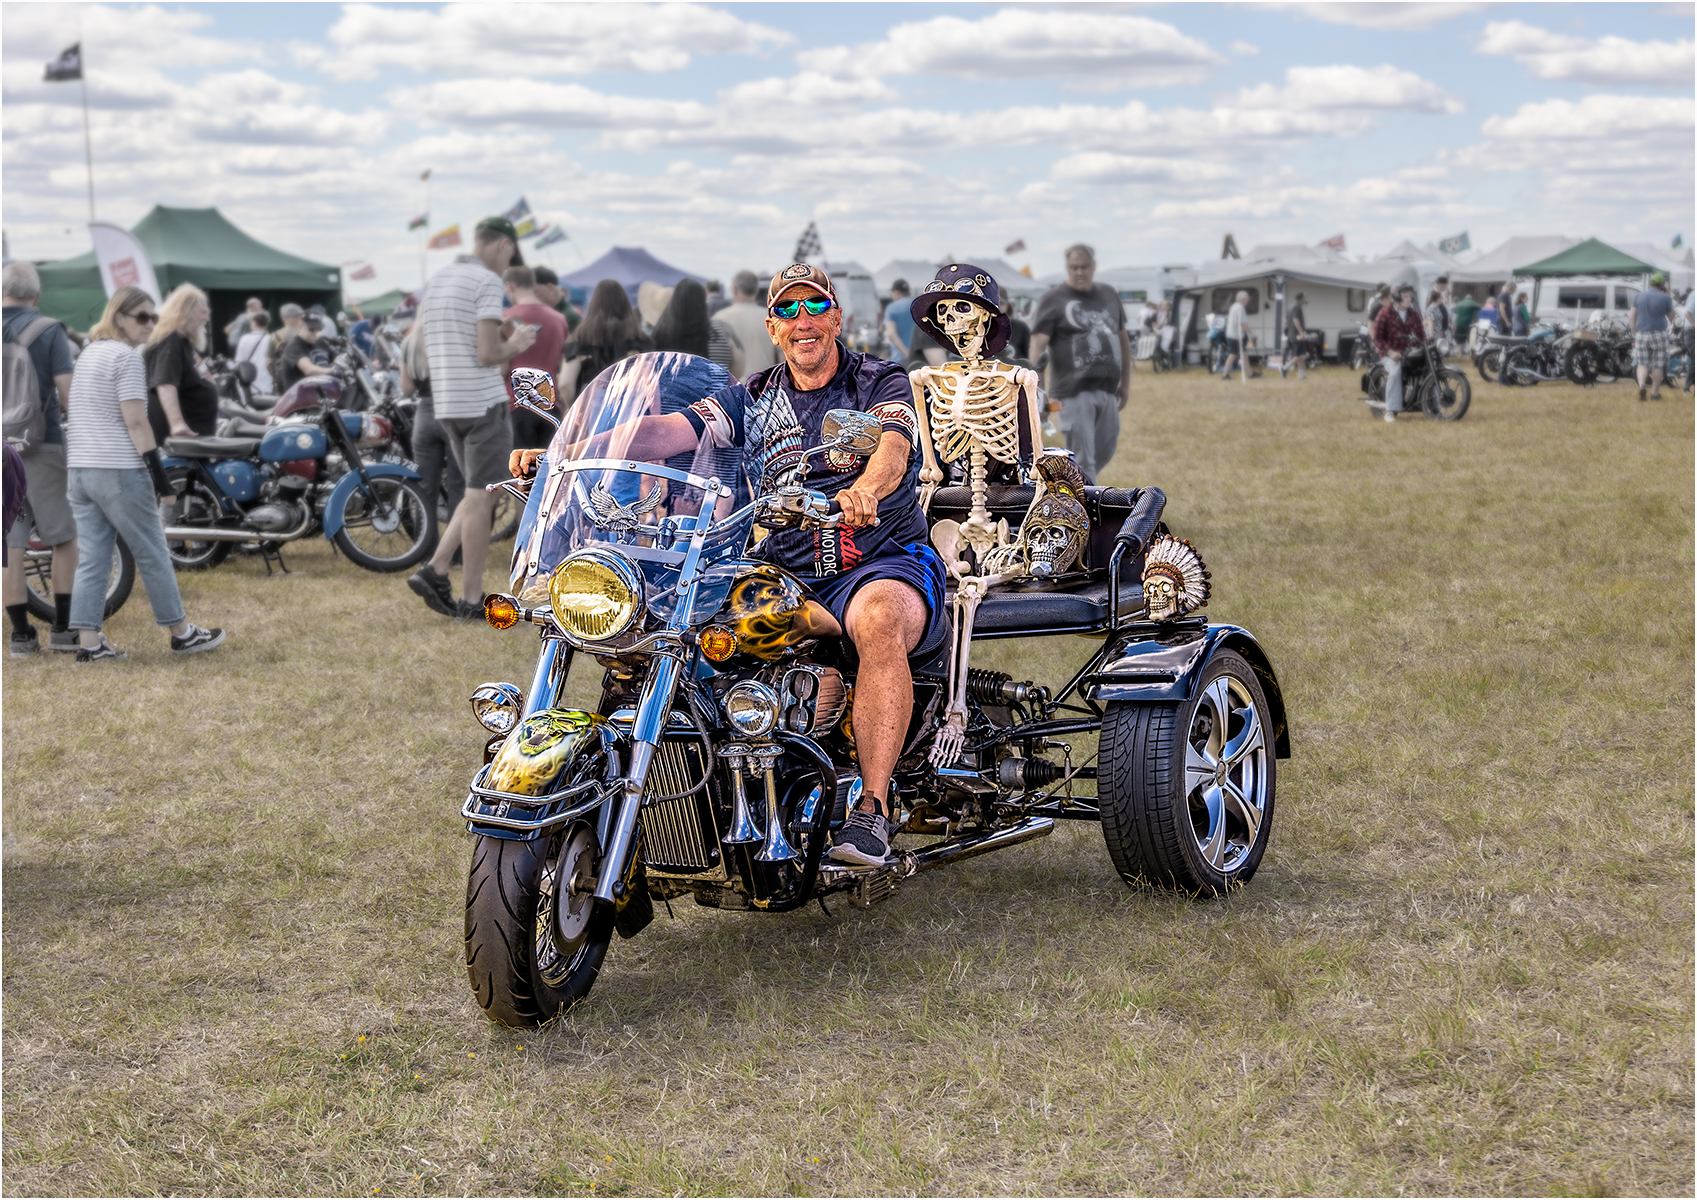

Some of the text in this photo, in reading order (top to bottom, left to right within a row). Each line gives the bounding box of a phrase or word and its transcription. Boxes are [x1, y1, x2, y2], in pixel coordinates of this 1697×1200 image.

[873, 407, 915, 430] Indian
[382, 454, 420, 473] AUB 72E
